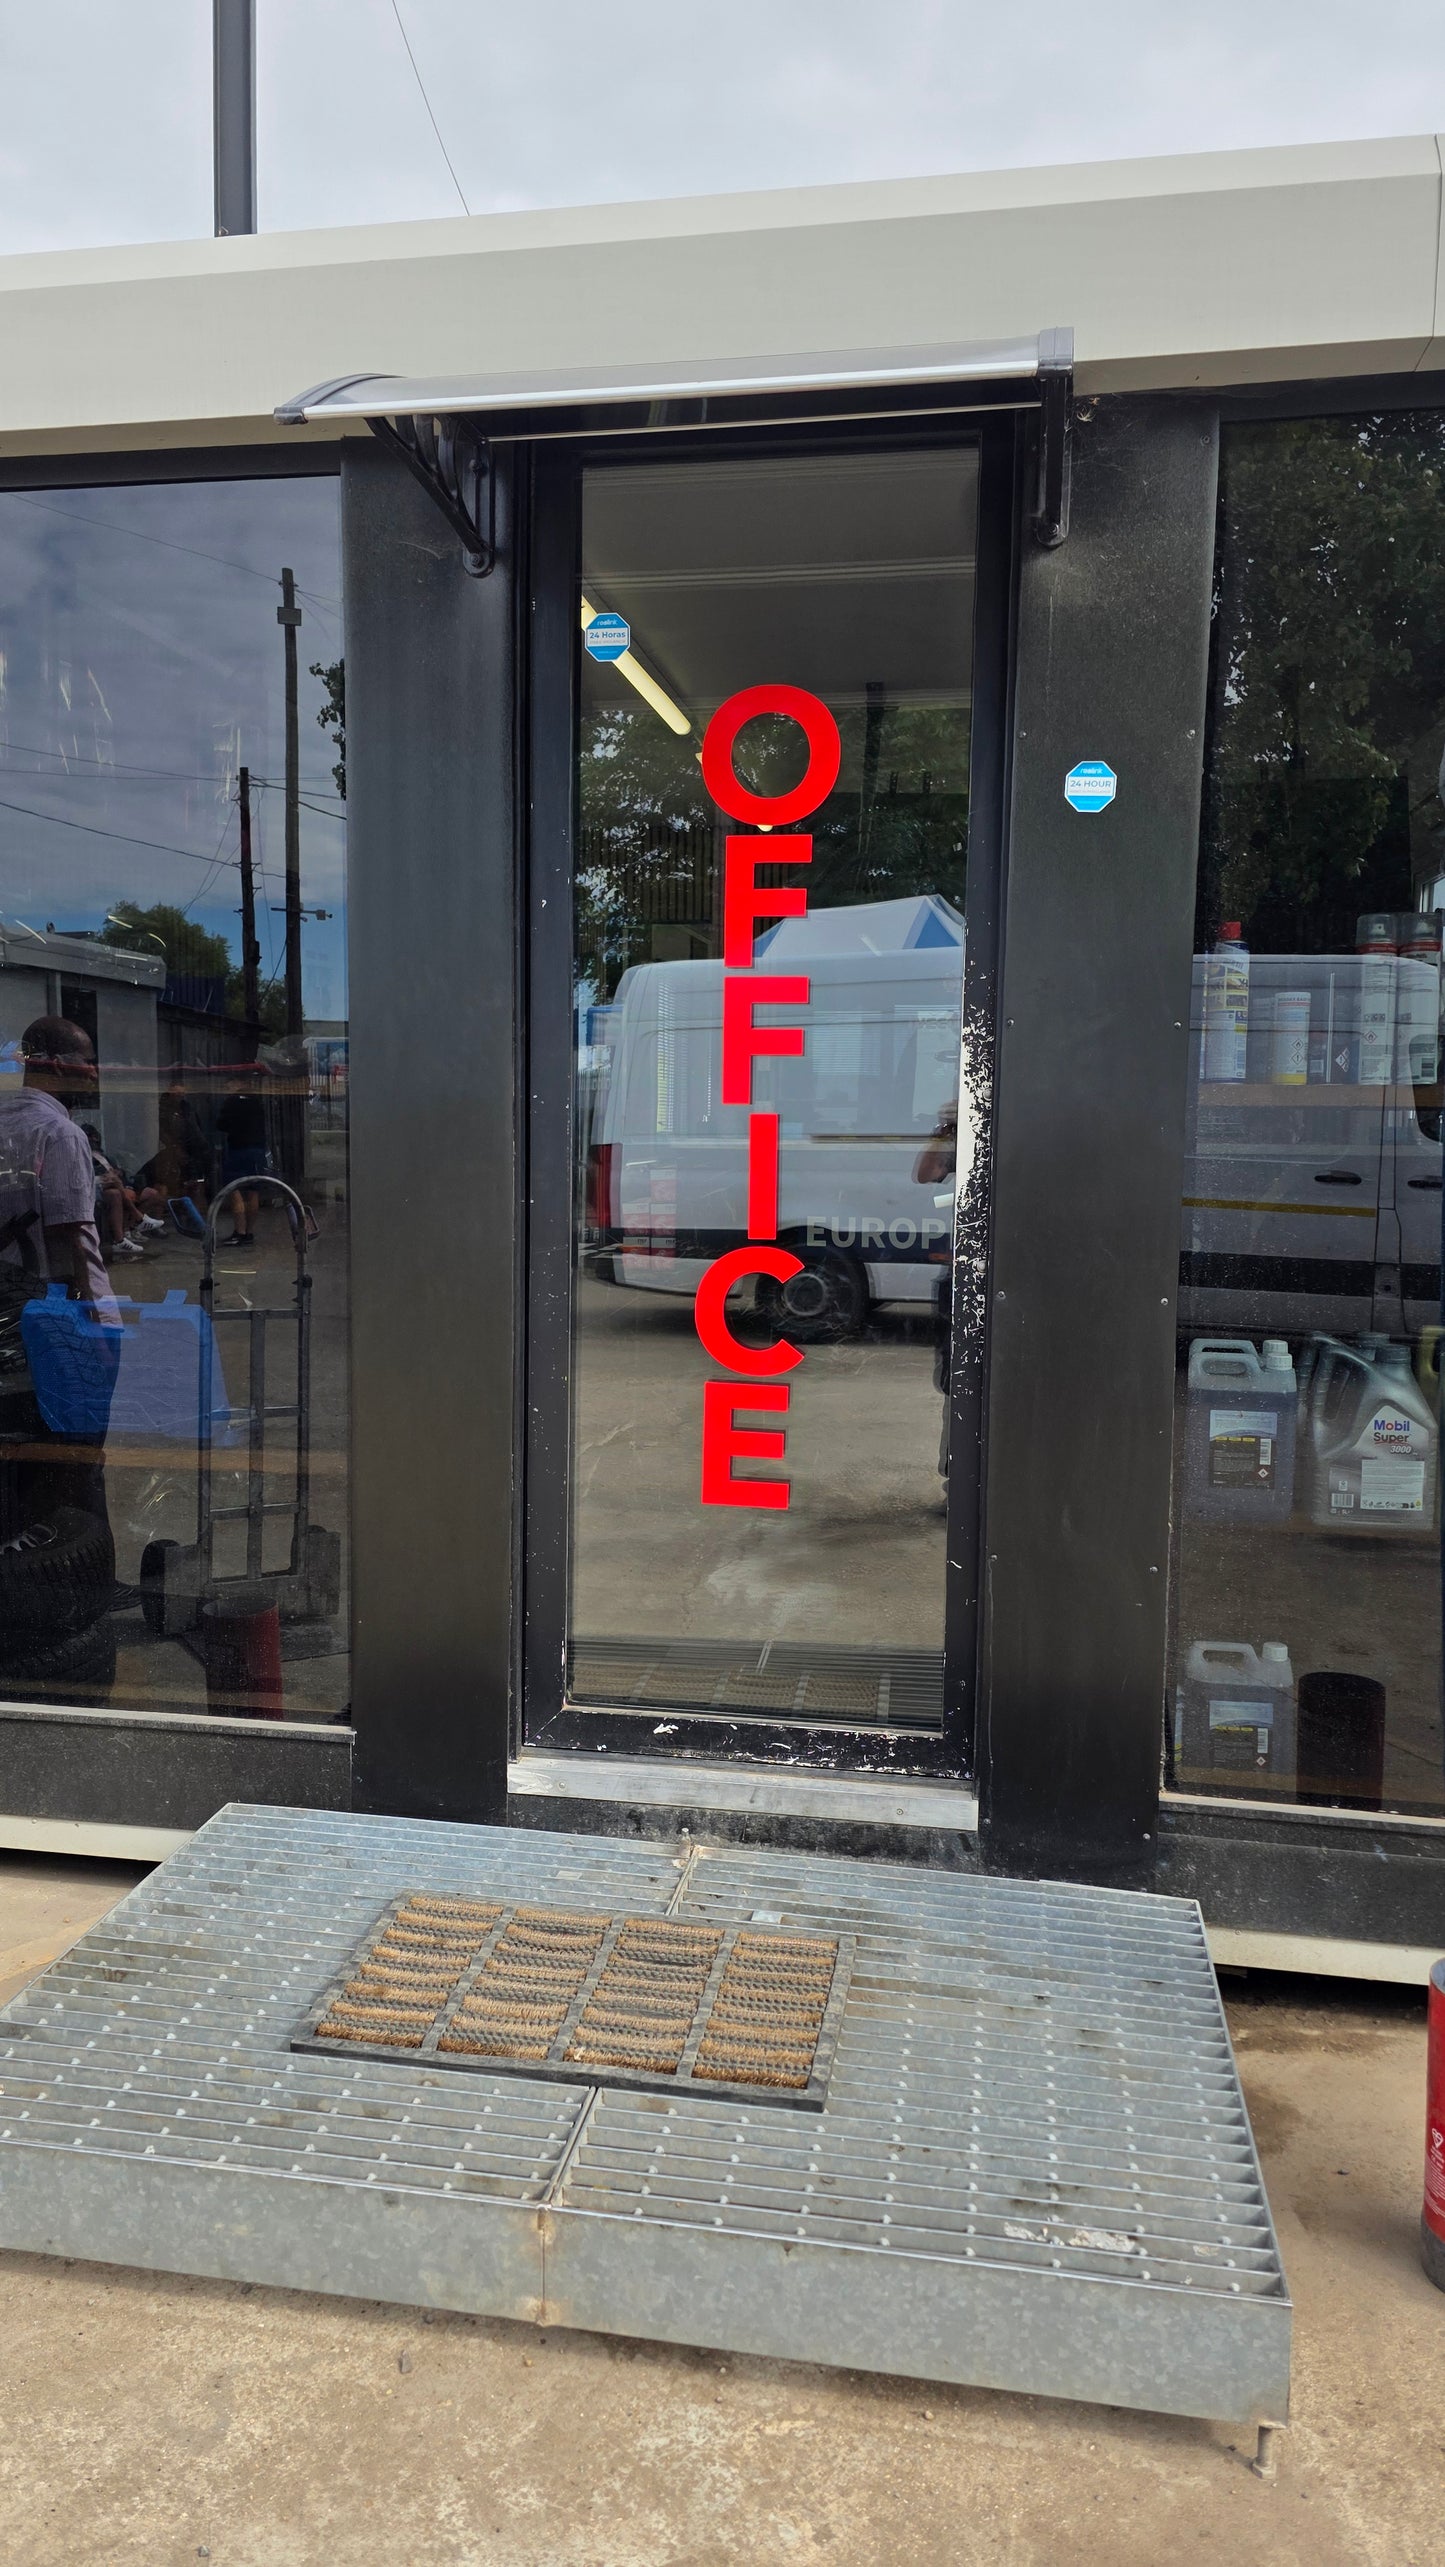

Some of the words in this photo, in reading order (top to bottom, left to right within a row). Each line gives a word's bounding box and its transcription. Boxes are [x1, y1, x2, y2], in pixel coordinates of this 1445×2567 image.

[601, 631, 626, 639] Horas
[1070, 780, 1082, 788] 24
[1084, 780, 1112, 788] HOUR
[694, 684, 841, 1510] OFFICE
[806, 1215, 953, 1250] EUROP
[1373, 1419, 1410, 1432] Mobil
[1373, 1431, 1409, 1444] Super
[1390, 1445, 1412, 1454] 3000
